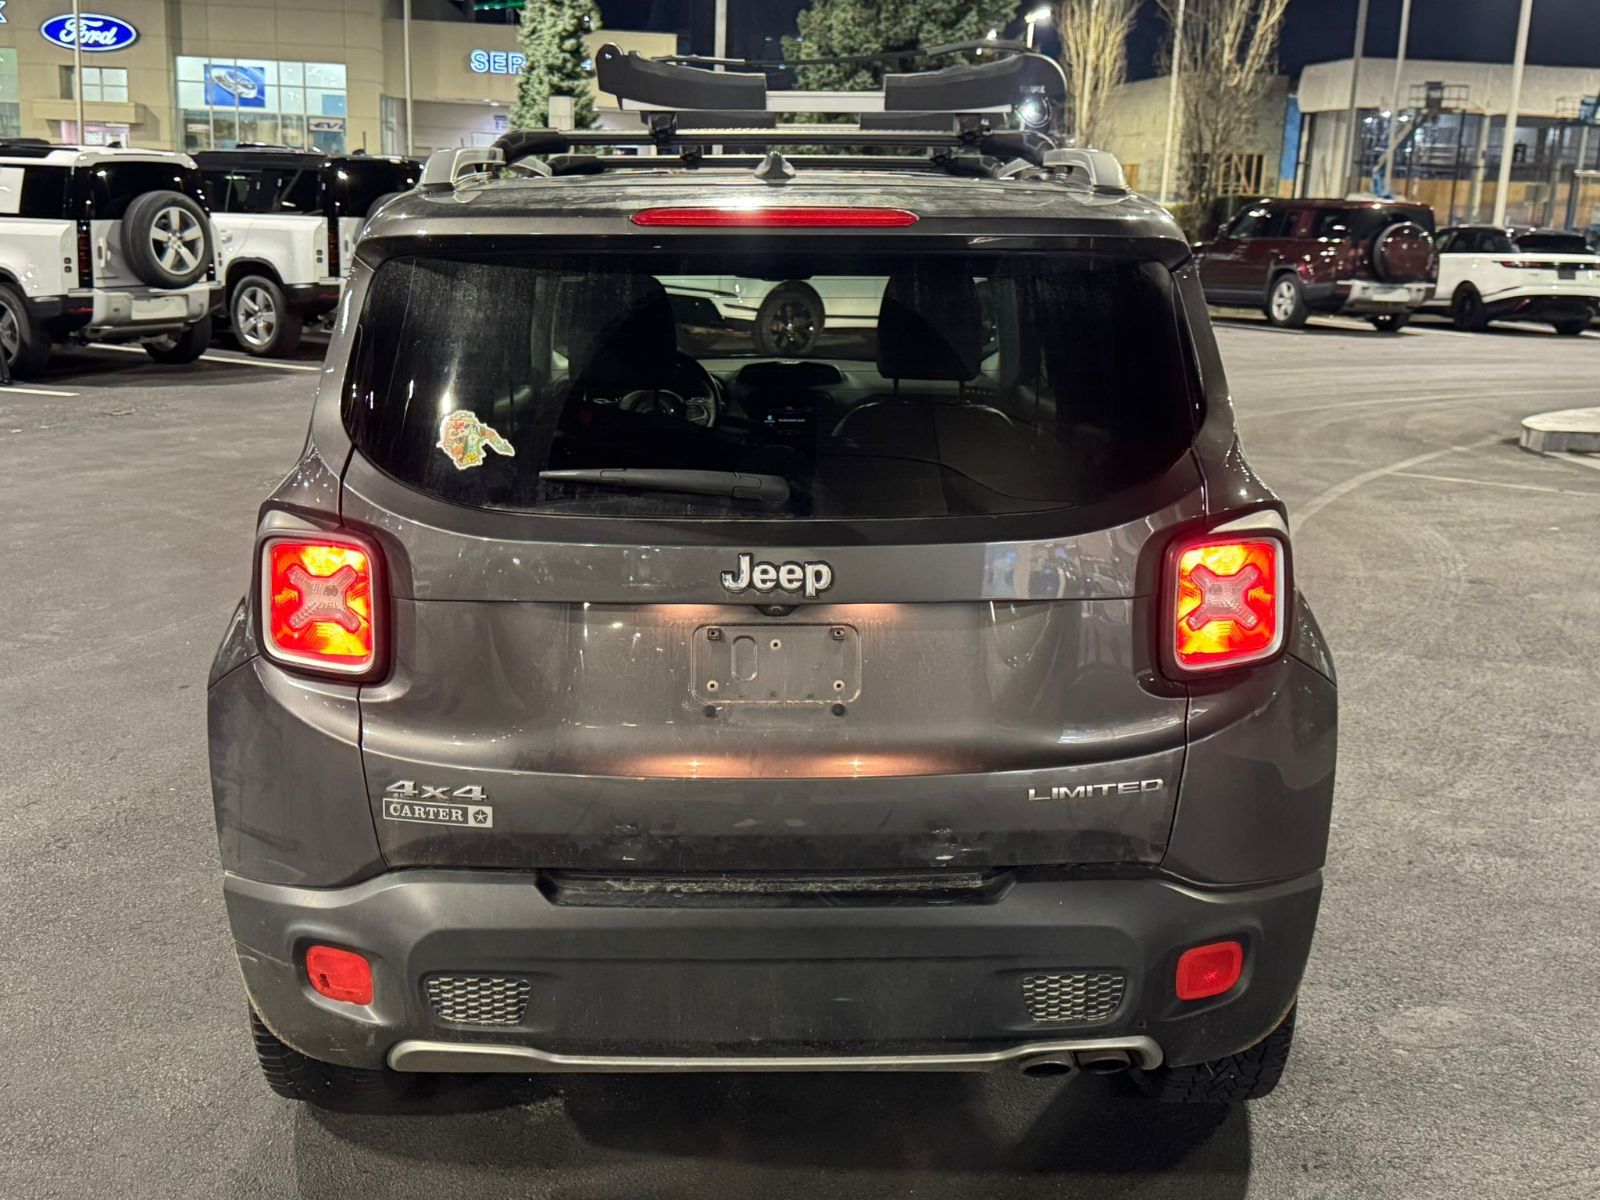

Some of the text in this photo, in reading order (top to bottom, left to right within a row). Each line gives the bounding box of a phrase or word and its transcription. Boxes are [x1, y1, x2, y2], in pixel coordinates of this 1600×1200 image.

[59, 18, 118, 45] Ford
[720, 553, 833, 599] Jeep
[385, 780, 489, 801] 4x4
[1028, 778, 1164, 801] LIMITED
[388, 803, 465, 822] CARTER
